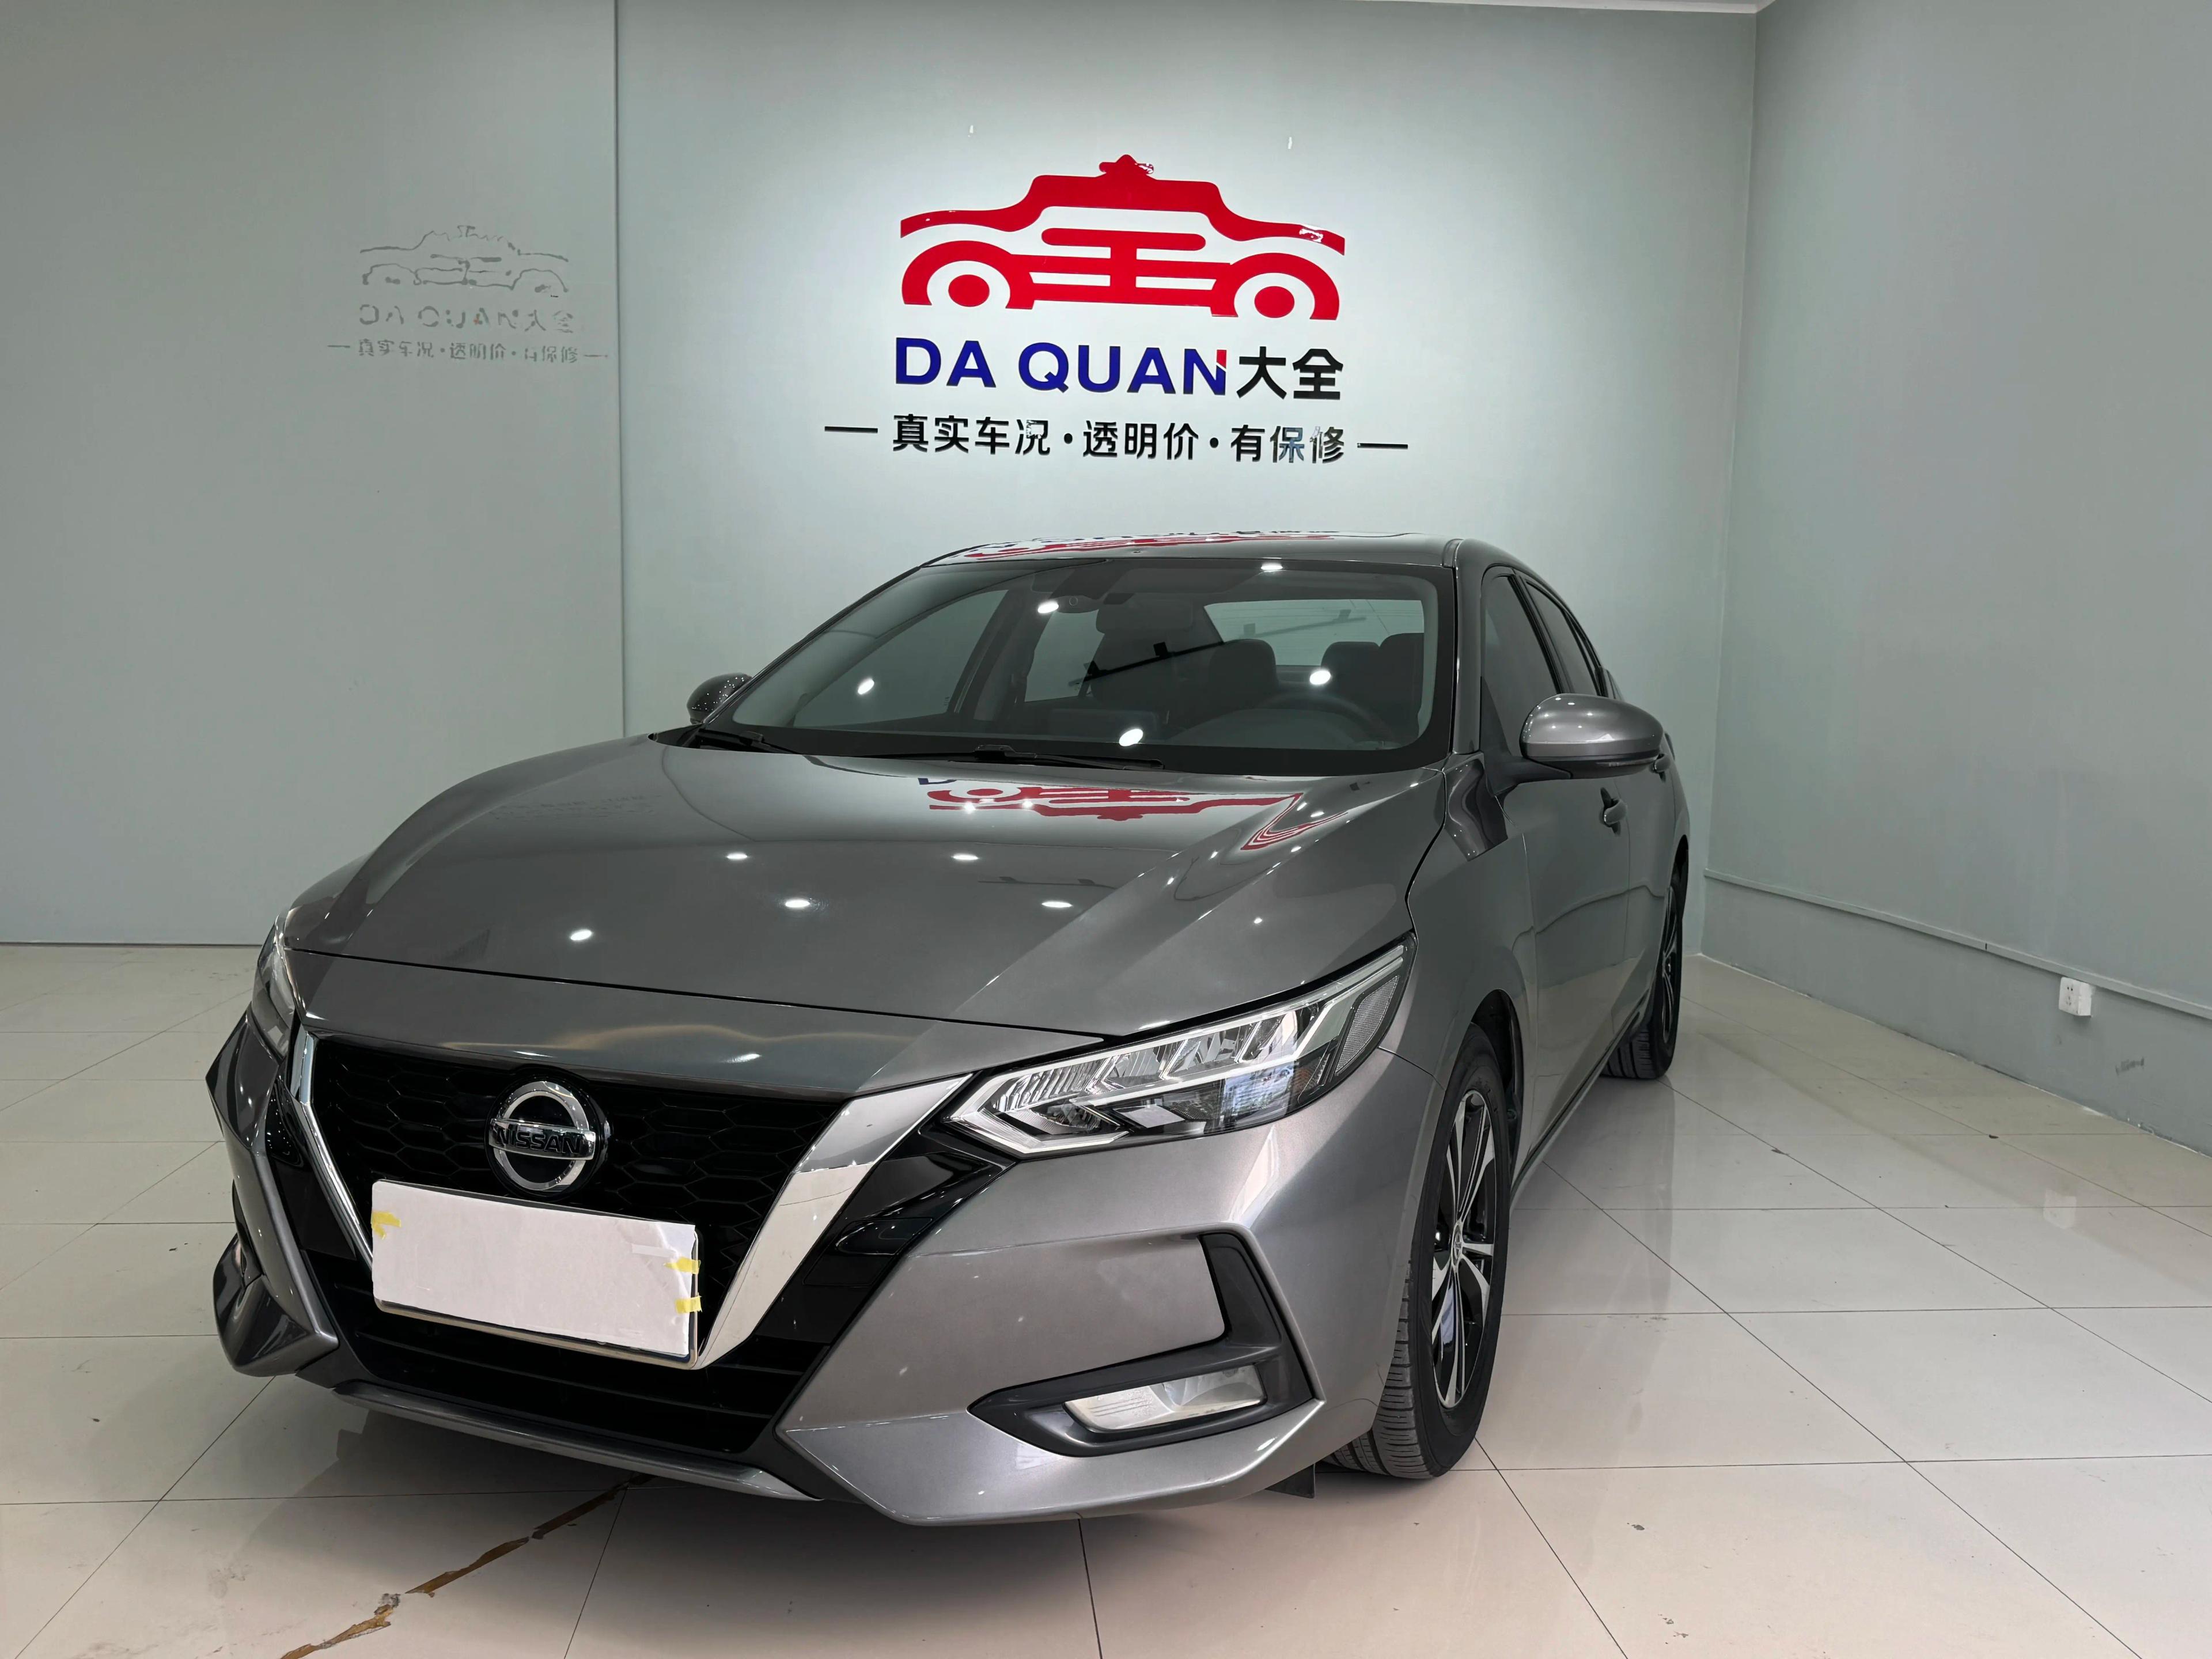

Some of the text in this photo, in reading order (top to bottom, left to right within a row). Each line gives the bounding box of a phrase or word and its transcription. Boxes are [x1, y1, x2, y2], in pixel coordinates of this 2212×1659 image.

[895, 337, 1344, 401] DA QUAN 大全
[495, 1126, 582, 1154] NISSAN
